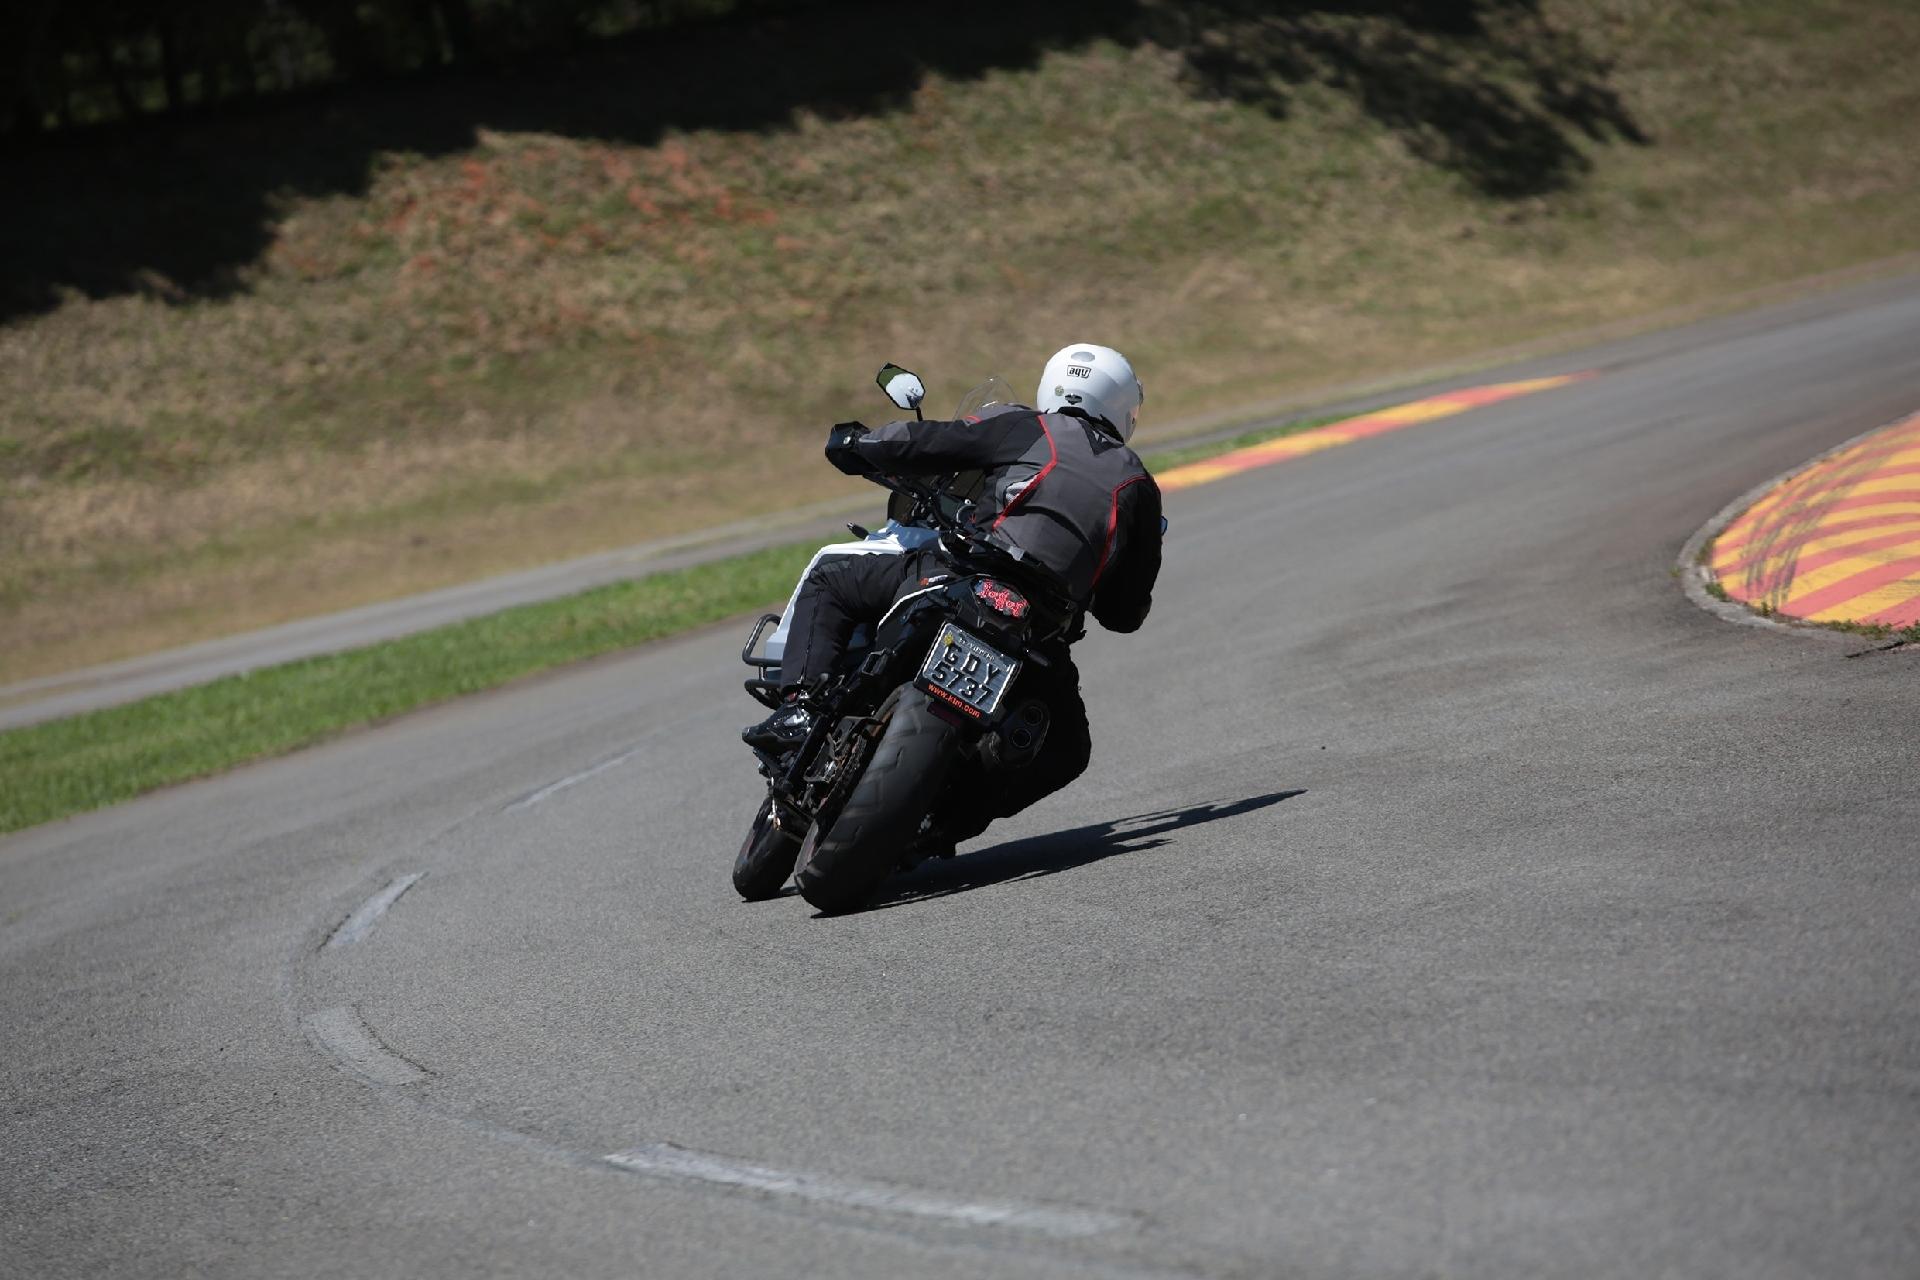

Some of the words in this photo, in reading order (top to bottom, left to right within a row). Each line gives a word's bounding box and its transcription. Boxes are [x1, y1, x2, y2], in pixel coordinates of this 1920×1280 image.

[932, 659, 993, 703] 5737
[943, 643, 1000, 685] GDY
[927, 683, 981, 718] www.ktm.com
